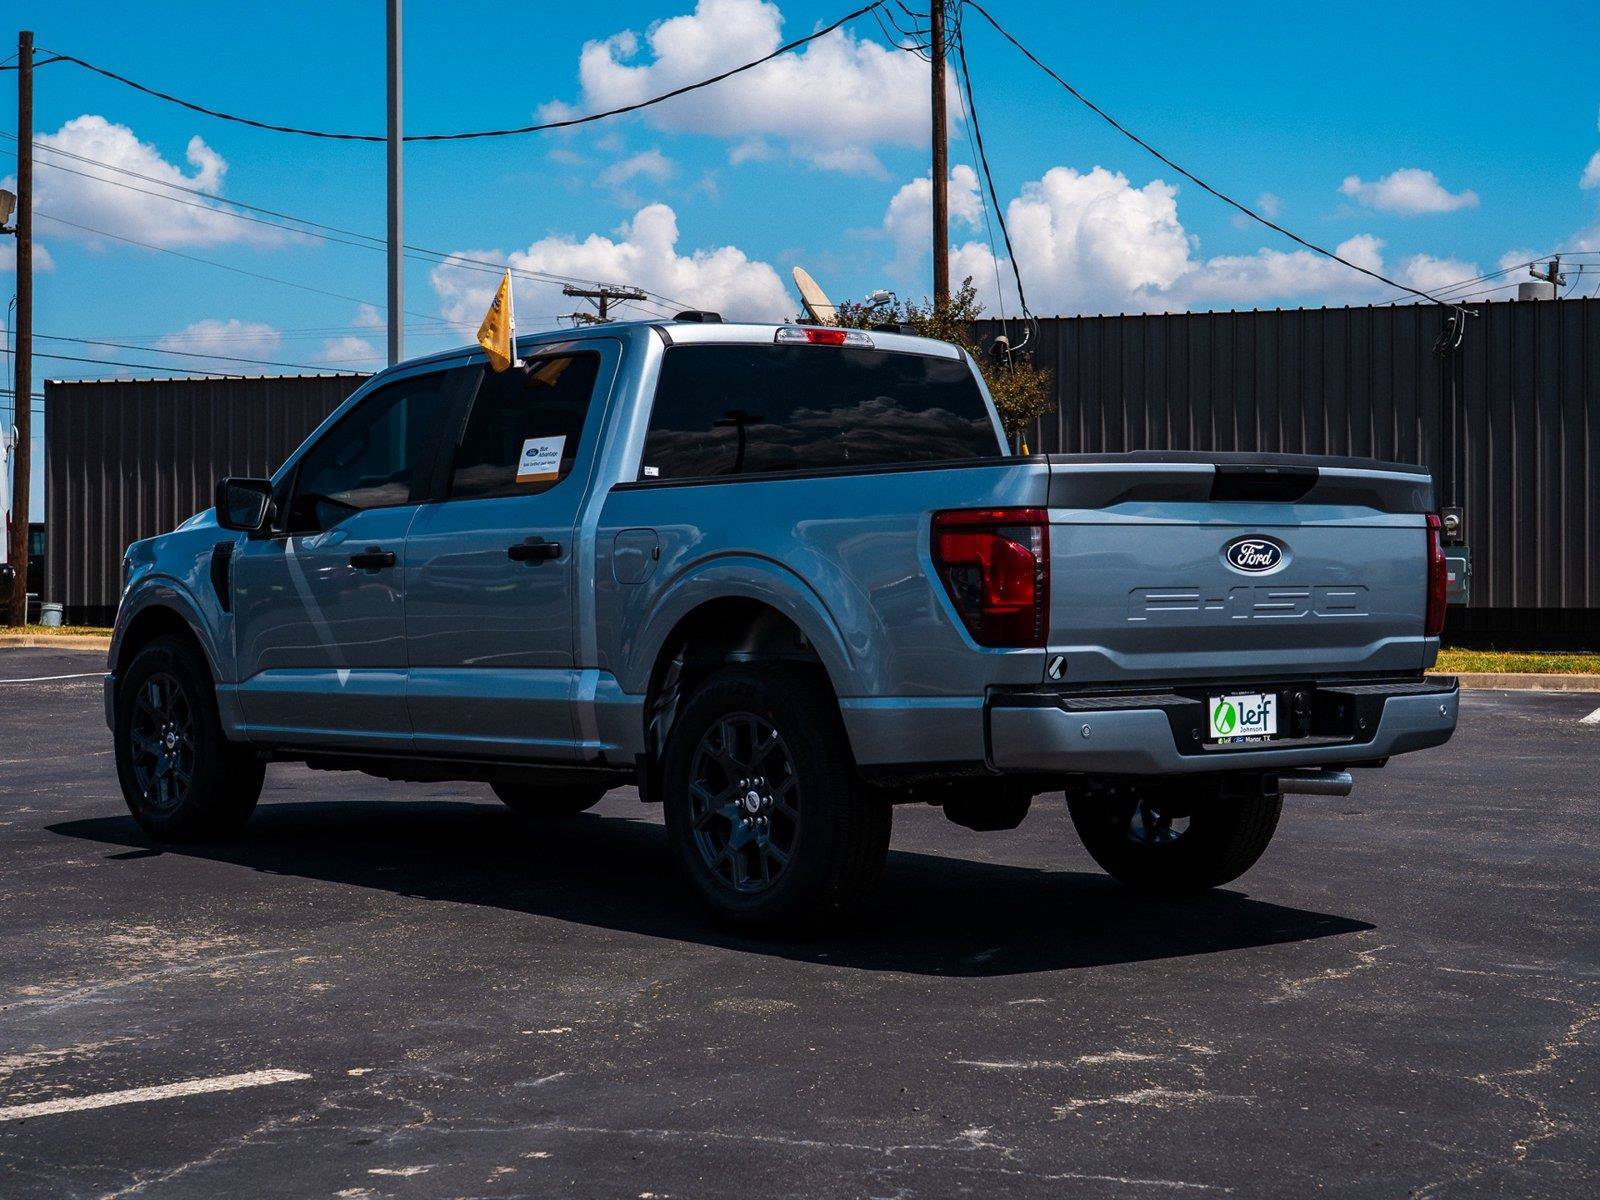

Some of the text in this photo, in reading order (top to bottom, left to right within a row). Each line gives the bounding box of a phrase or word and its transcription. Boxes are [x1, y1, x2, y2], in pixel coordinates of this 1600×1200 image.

[1237, 543, 1272, 566] Ford
[1127, 585, 1370, 621] F-150
[1263, 734, 1271, 742] TX
